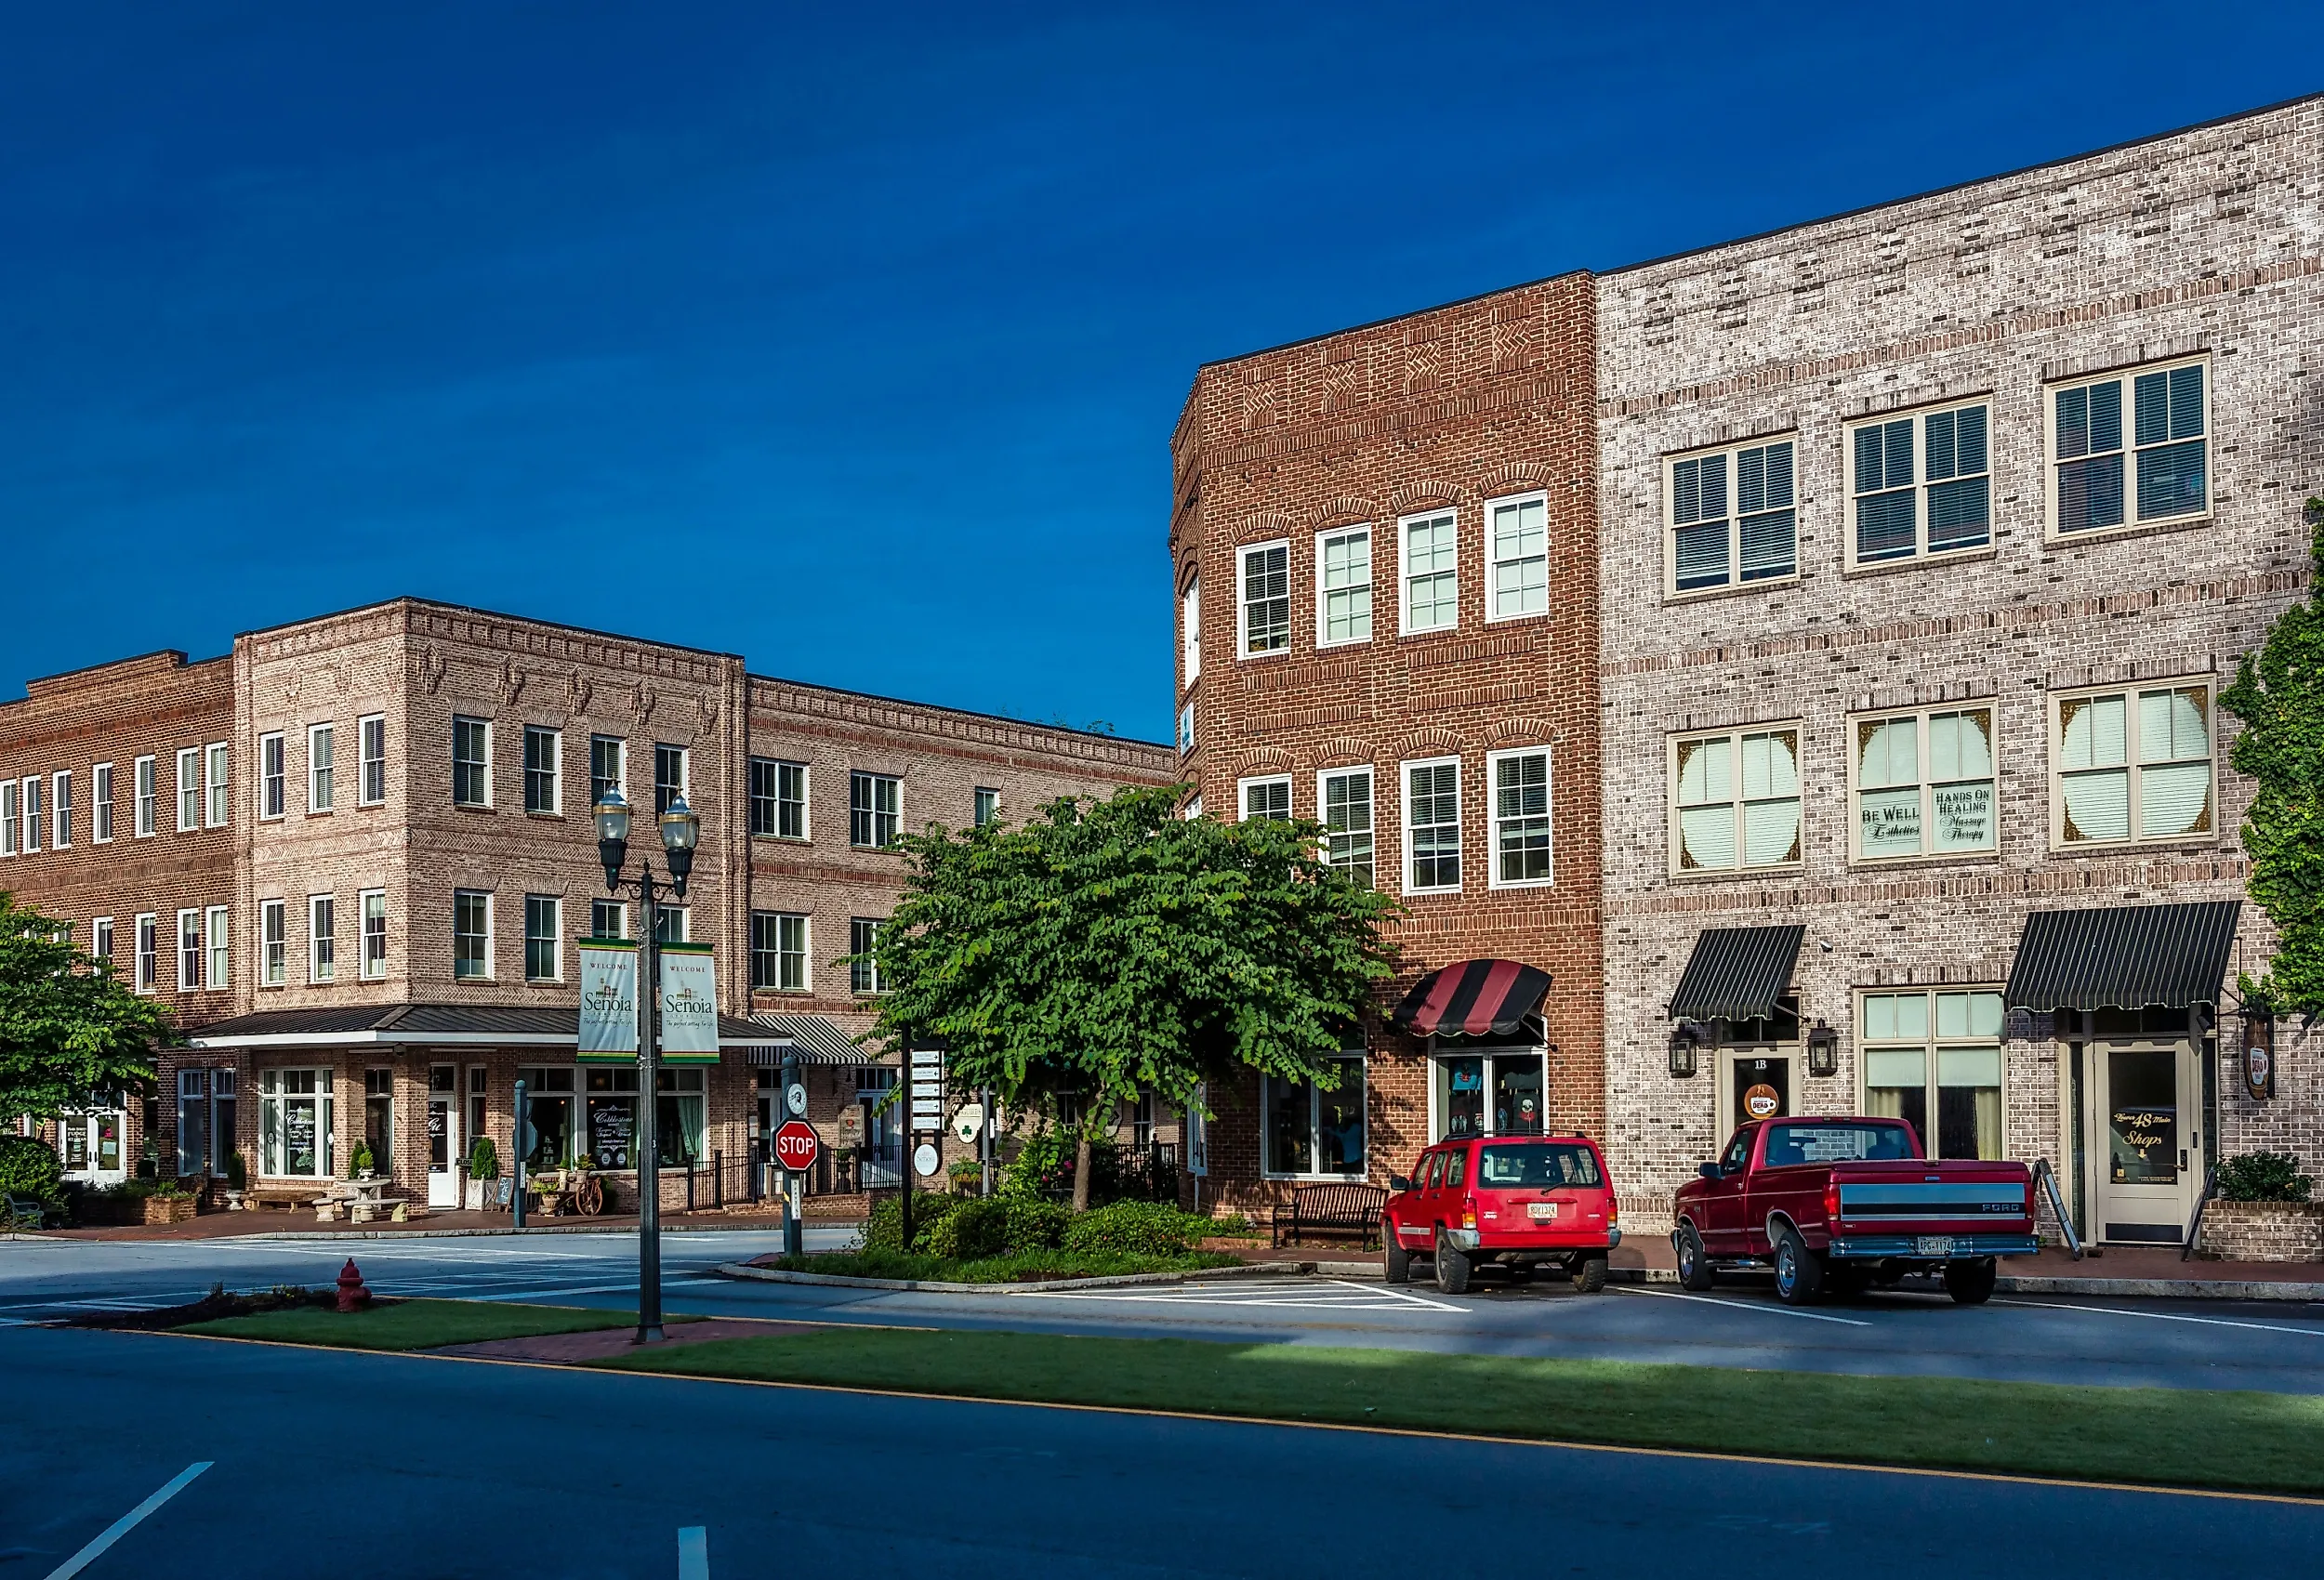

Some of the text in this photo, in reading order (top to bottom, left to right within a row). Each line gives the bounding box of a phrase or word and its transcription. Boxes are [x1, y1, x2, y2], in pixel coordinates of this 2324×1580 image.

[1936, 789, 1990, 804] HANDS ON
[1862, 805, 1920, 823] BE WELL
[1939, 801, 1987, 815] HEALING
[1939, 815, 1987, 828] Massage
[1942, 826, 1984, 842] Therapy
[584, 992, 632, 1011] Senoia
[666, 994, 713, 1013] Senoia
[1755, 1060, 1766, 1070] 1B
[2132, 1113, 2153, 1127] 48
[779, 1136, 814, 1155] STOP
[2122, 1130, 2162, 1148] Shops
[1982, 1204, 2020, 1212] FORD
